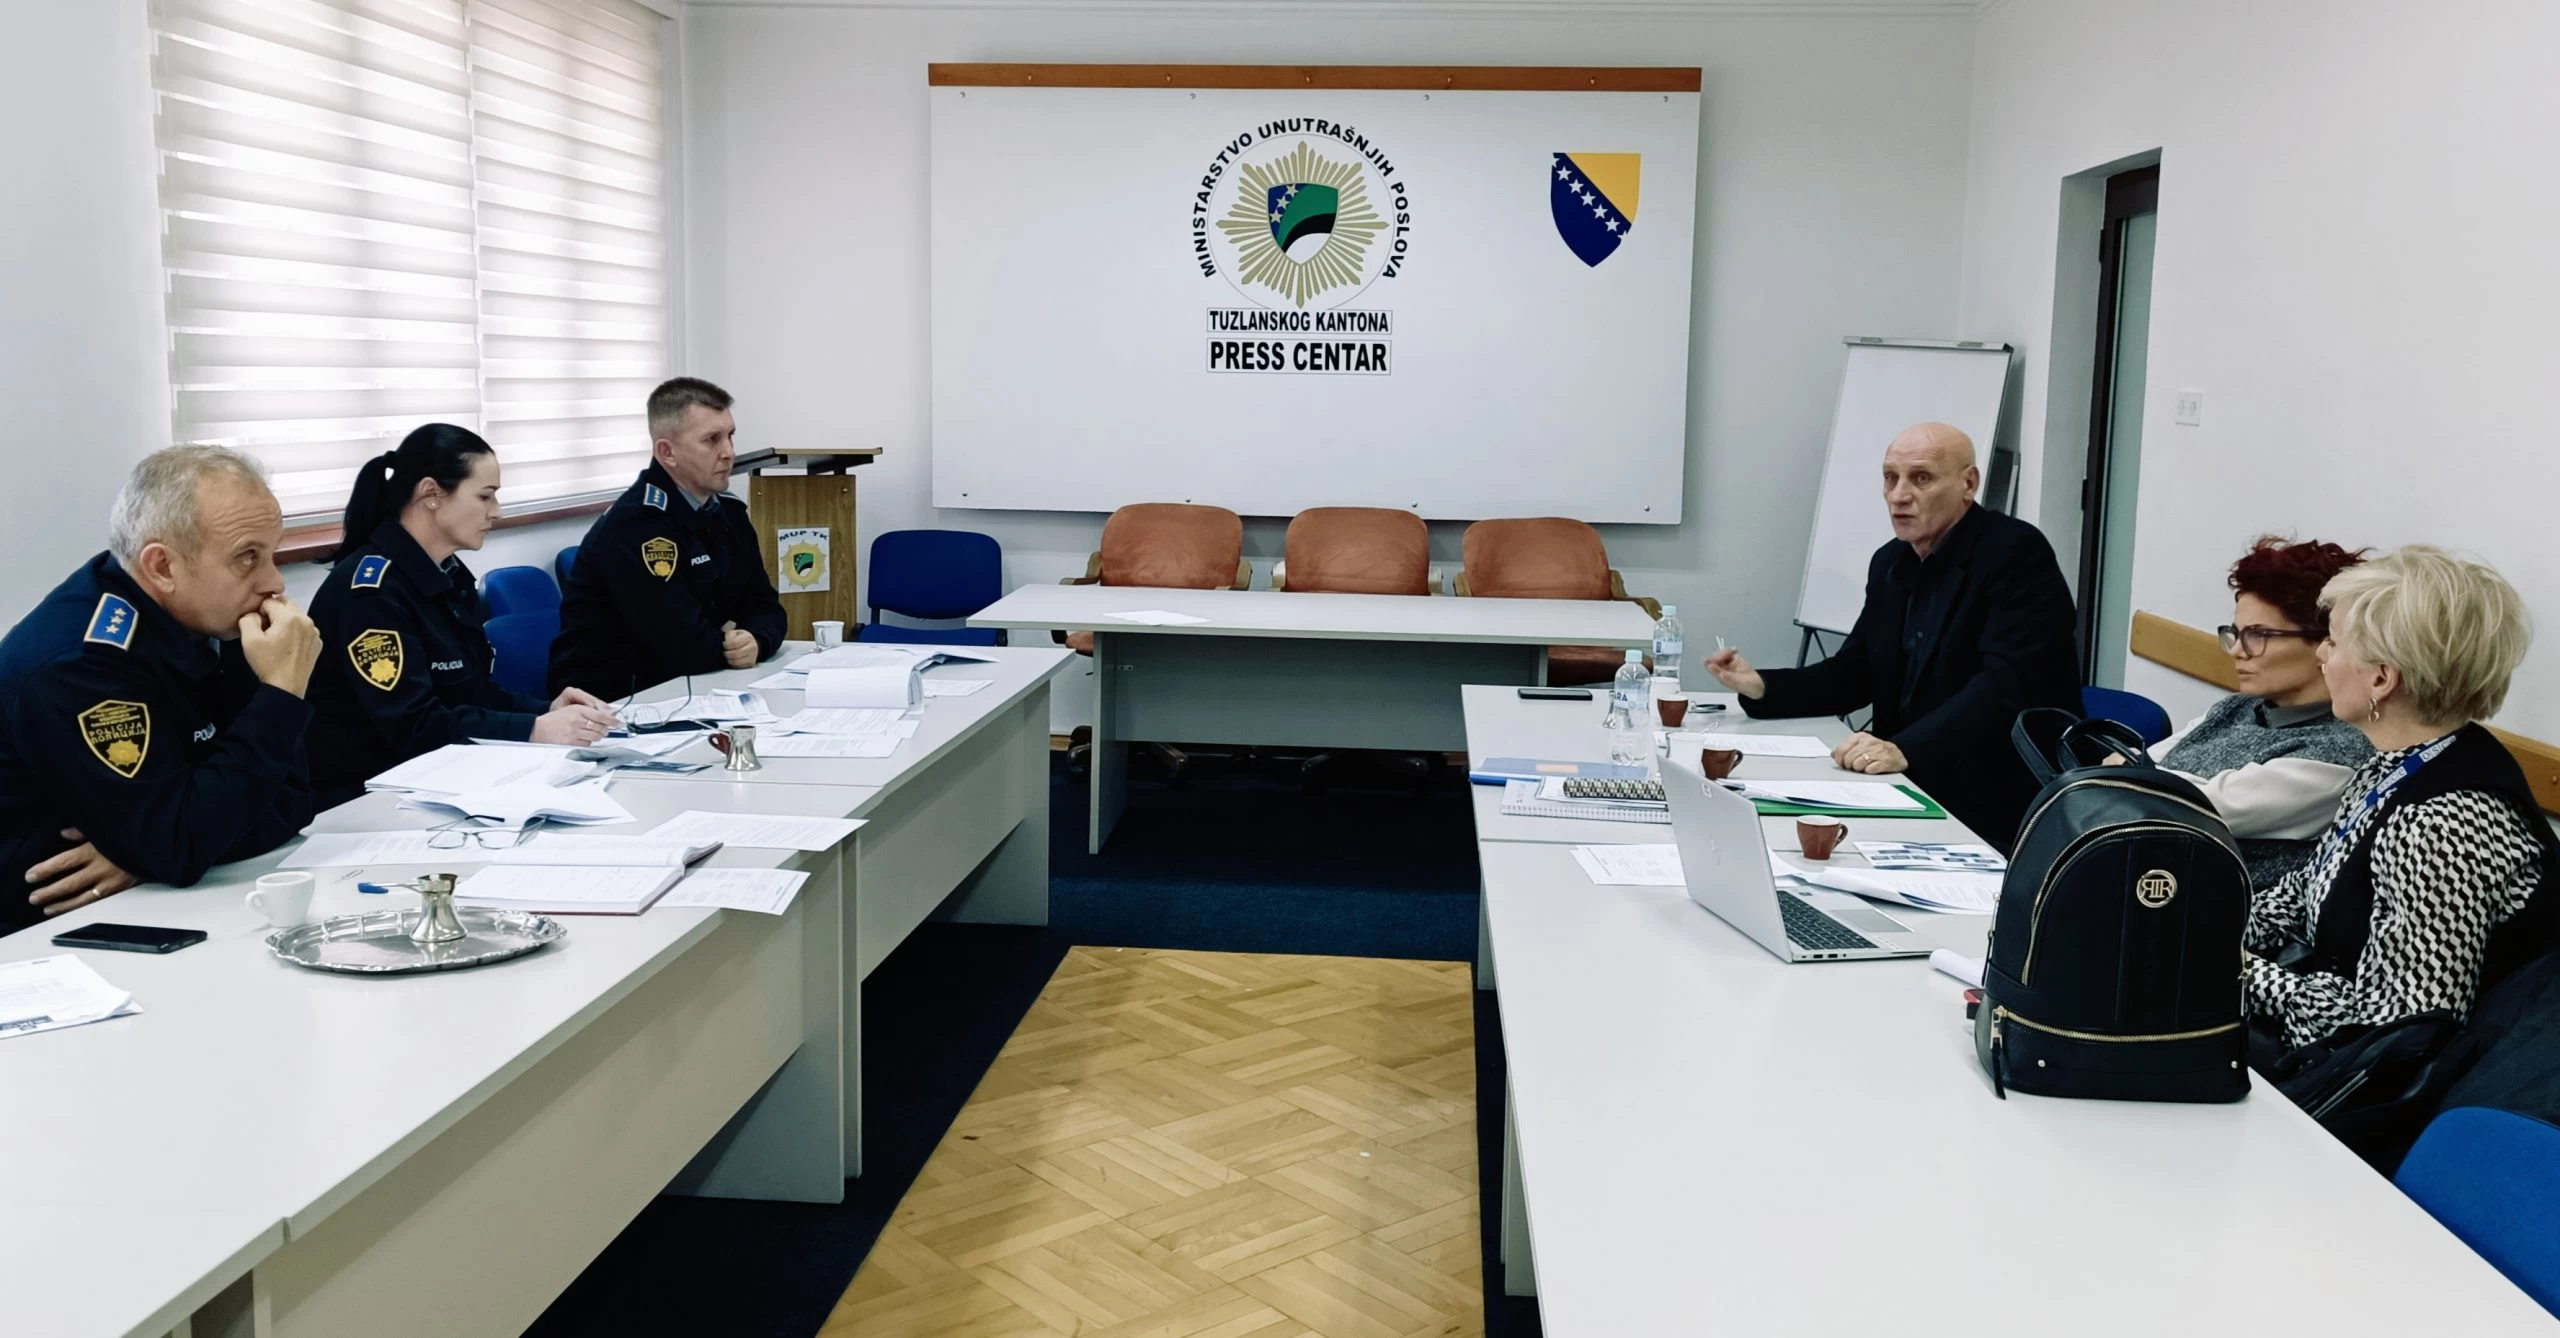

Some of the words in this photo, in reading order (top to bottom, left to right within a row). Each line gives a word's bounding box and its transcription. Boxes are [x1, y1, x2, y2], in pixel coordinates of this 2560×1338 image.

[1193, 132, 1253, 278] MINISTARSTVO
[1257, 117, 1395, 177] UNUTRAŠNJIH
[1382, 182, 1410, 279] POSLOVA
[1209, 310, 1311, 331] TUZLANSKOG
[1315, 311, 1389, 332] KANTONA
[1210, 341, 1285, 371] PRESS
[1293, 342, 1388, 372] CENTAR
[779, 530, 807, 541] MUP
[811, 531, 828, 540] TK
[89, 721, 143, 737] POLICIJA
